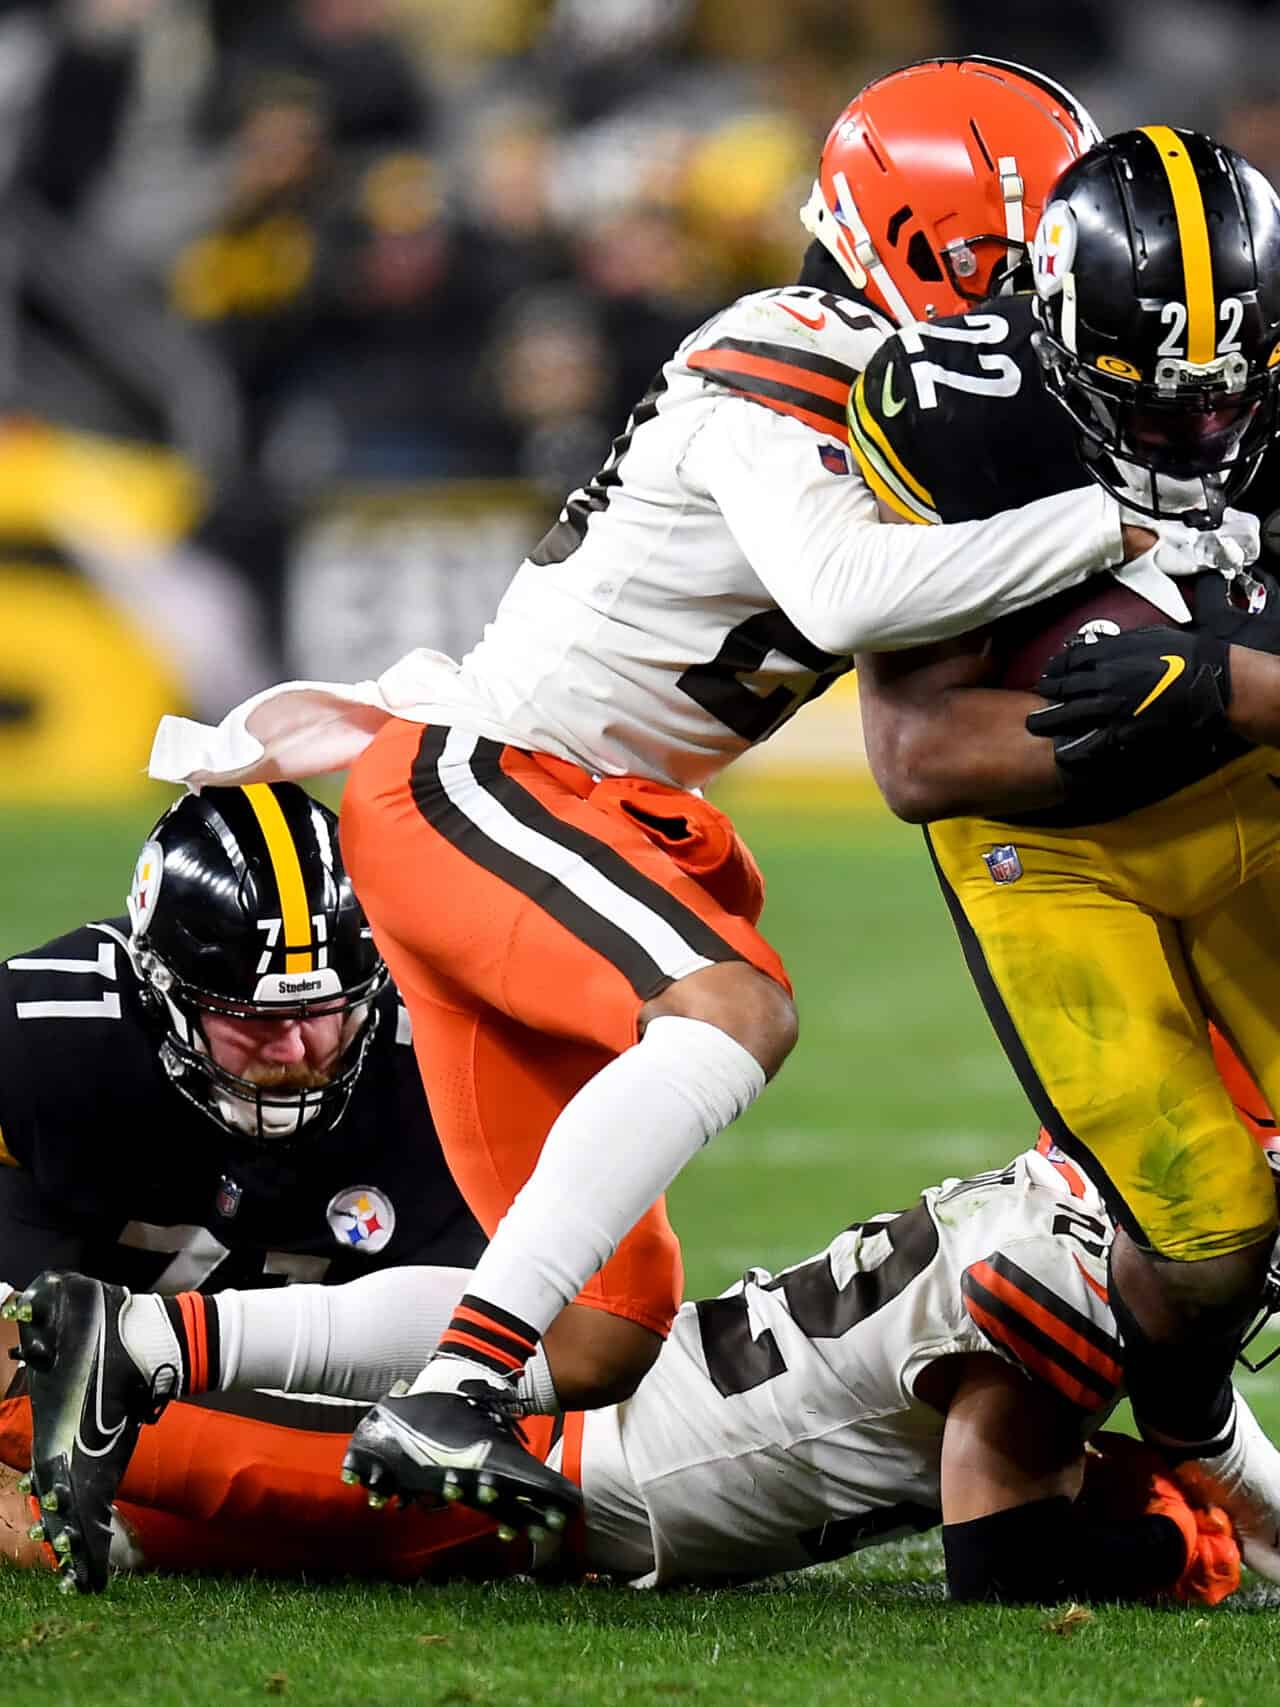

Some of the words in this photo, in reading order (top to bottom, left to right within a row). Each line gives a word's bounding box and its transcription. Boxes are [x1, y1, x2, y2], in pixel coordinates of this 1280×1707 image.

[1157, 297, 1243, 356] 22
[895, 313, 1022, 408] 22
[256, 914, 328, 974] 71
[8, 943, 122, 1019] 71
[278, 979, 322, 994] Steelers
